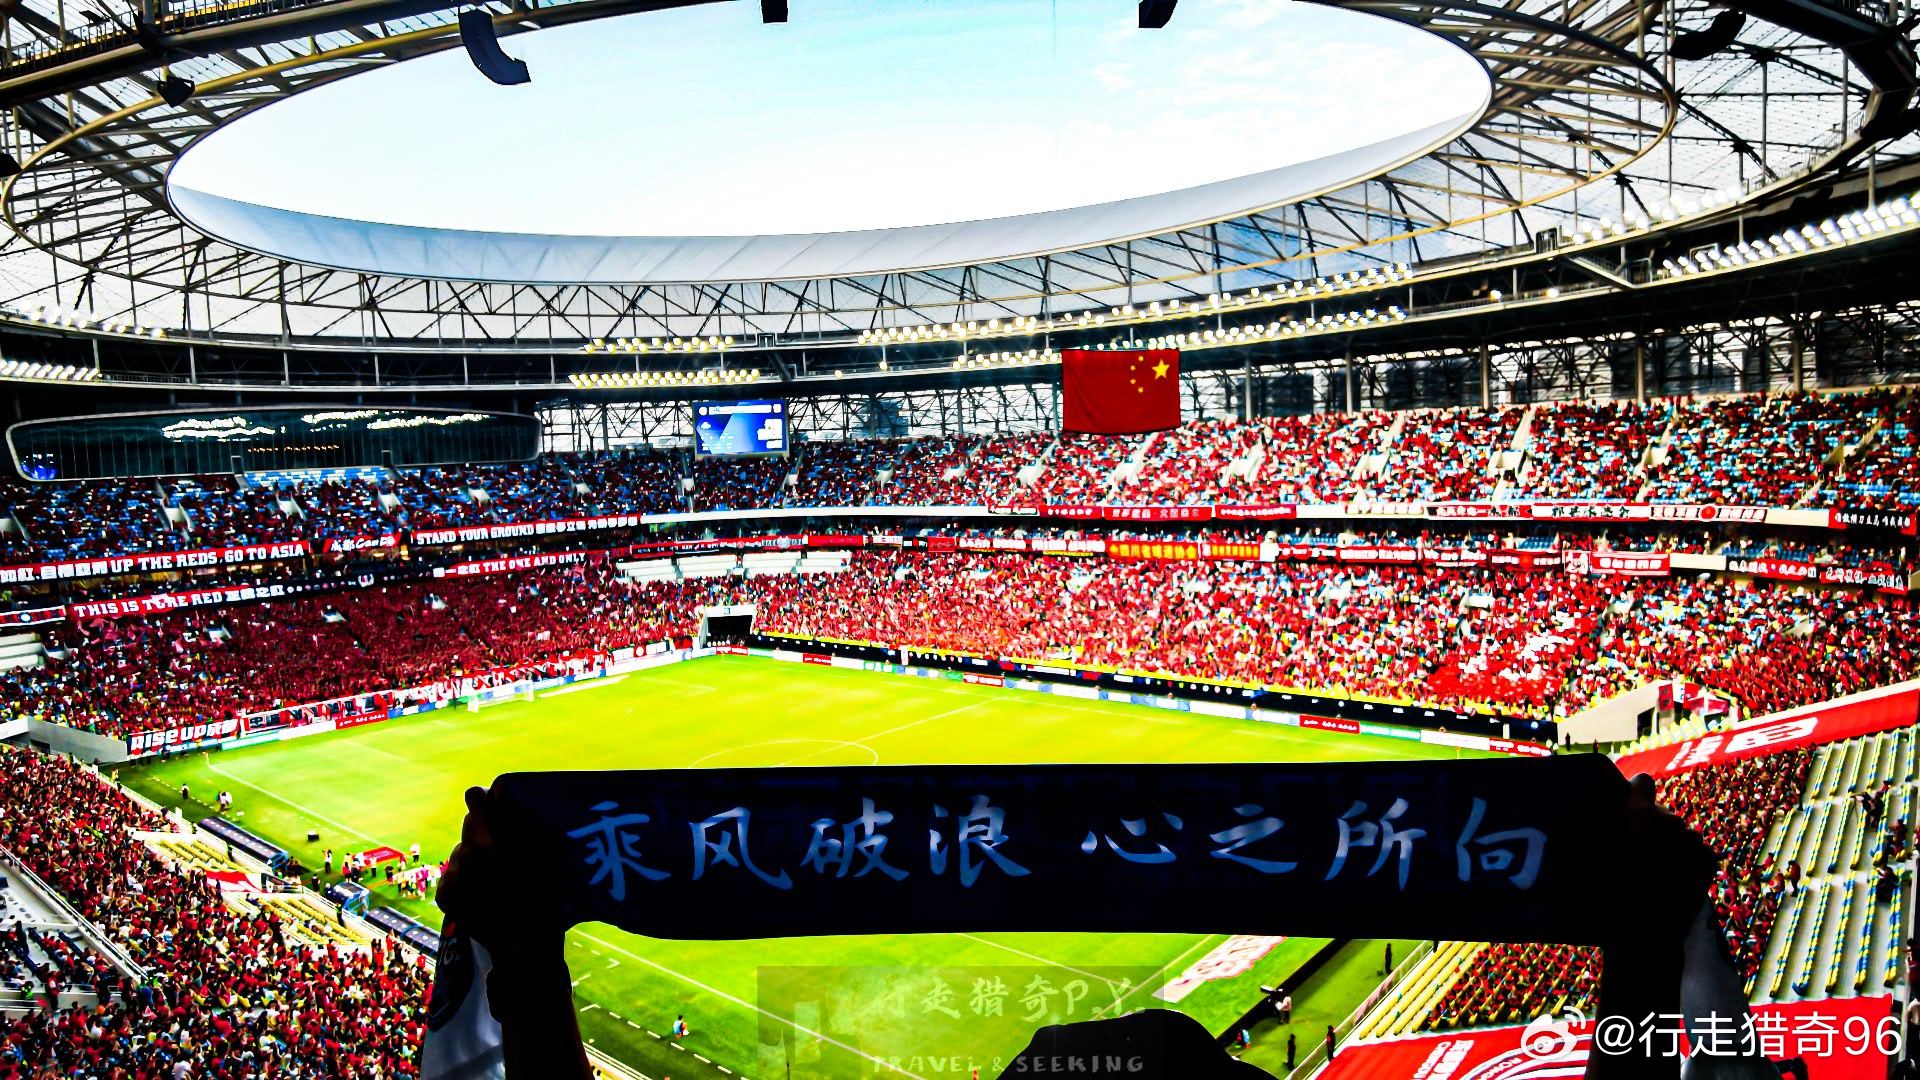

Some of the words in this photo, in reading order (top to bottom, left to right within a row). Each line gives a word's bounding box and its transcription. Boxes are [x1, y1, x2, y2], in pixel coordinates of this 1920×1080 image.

[416, 530, 456, 545] STAND
[459, 528, 489, 541] YOUR
[490, 524, 535, 539] GROUND
[111, 558, 132, 573] UP
[138, 554, 172, 571] THE
[246, 547, 267, 561] TO
[270, 543, 304, 558] ASIA
[483, 561, 507, 572] THE
[508, 558, 532, 569] ONE
[534, 555, 557, 567] AND
[558, 551, 586, 564] ONLY
[75, 603, 117, 618] THIS
[122, 601, 139, 614] IS
[191, 592, 223, 606] RED
[180, 725, 207, 741] UP
[567, 795, 1032, 901] 乘风破浪
[1081, 798, 1547, 890] 心之所向
